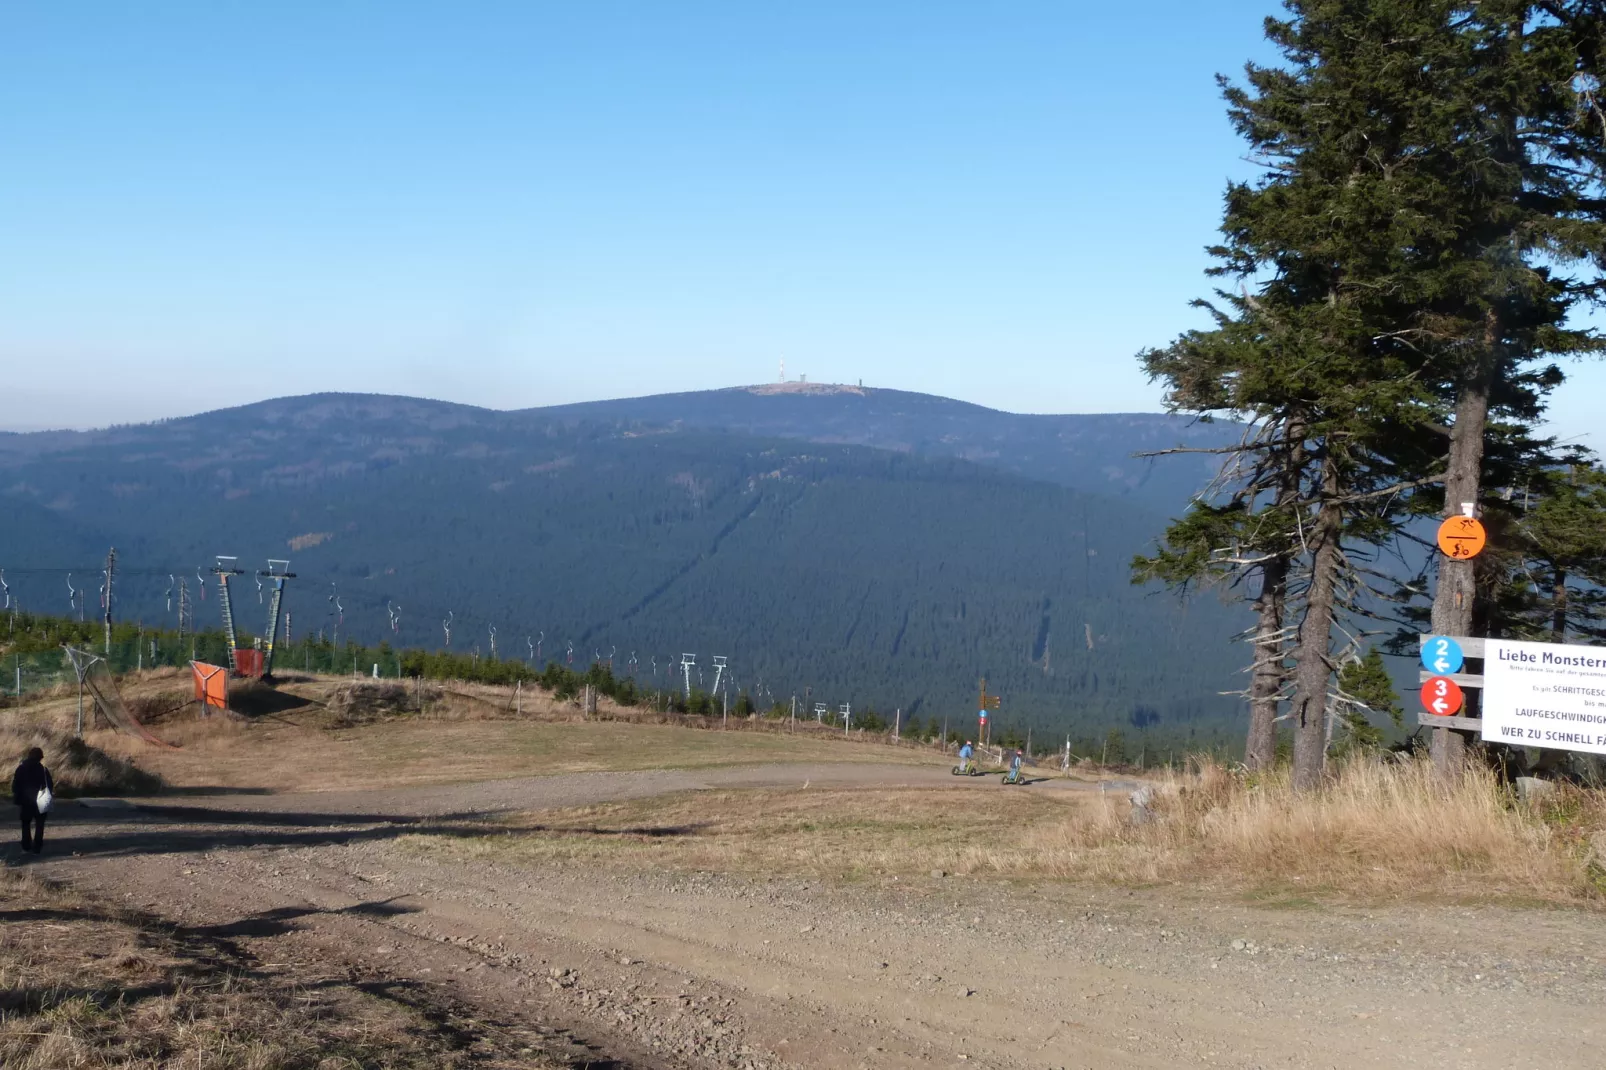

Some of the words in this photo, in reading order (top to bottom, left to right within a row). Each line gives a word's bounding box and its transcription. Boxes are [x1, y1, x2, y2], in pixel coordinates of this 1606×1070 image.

[1436, 640, 1448, 656] 2
[1499, 648, 1536, 662] Liebe
[1435, 680, 1447, 696] 3
[1501, 726, 1524, 737] WER
[1528, 729, 1541, 739] ZU
[1545, 730, 1593, 744] SCHNELL
